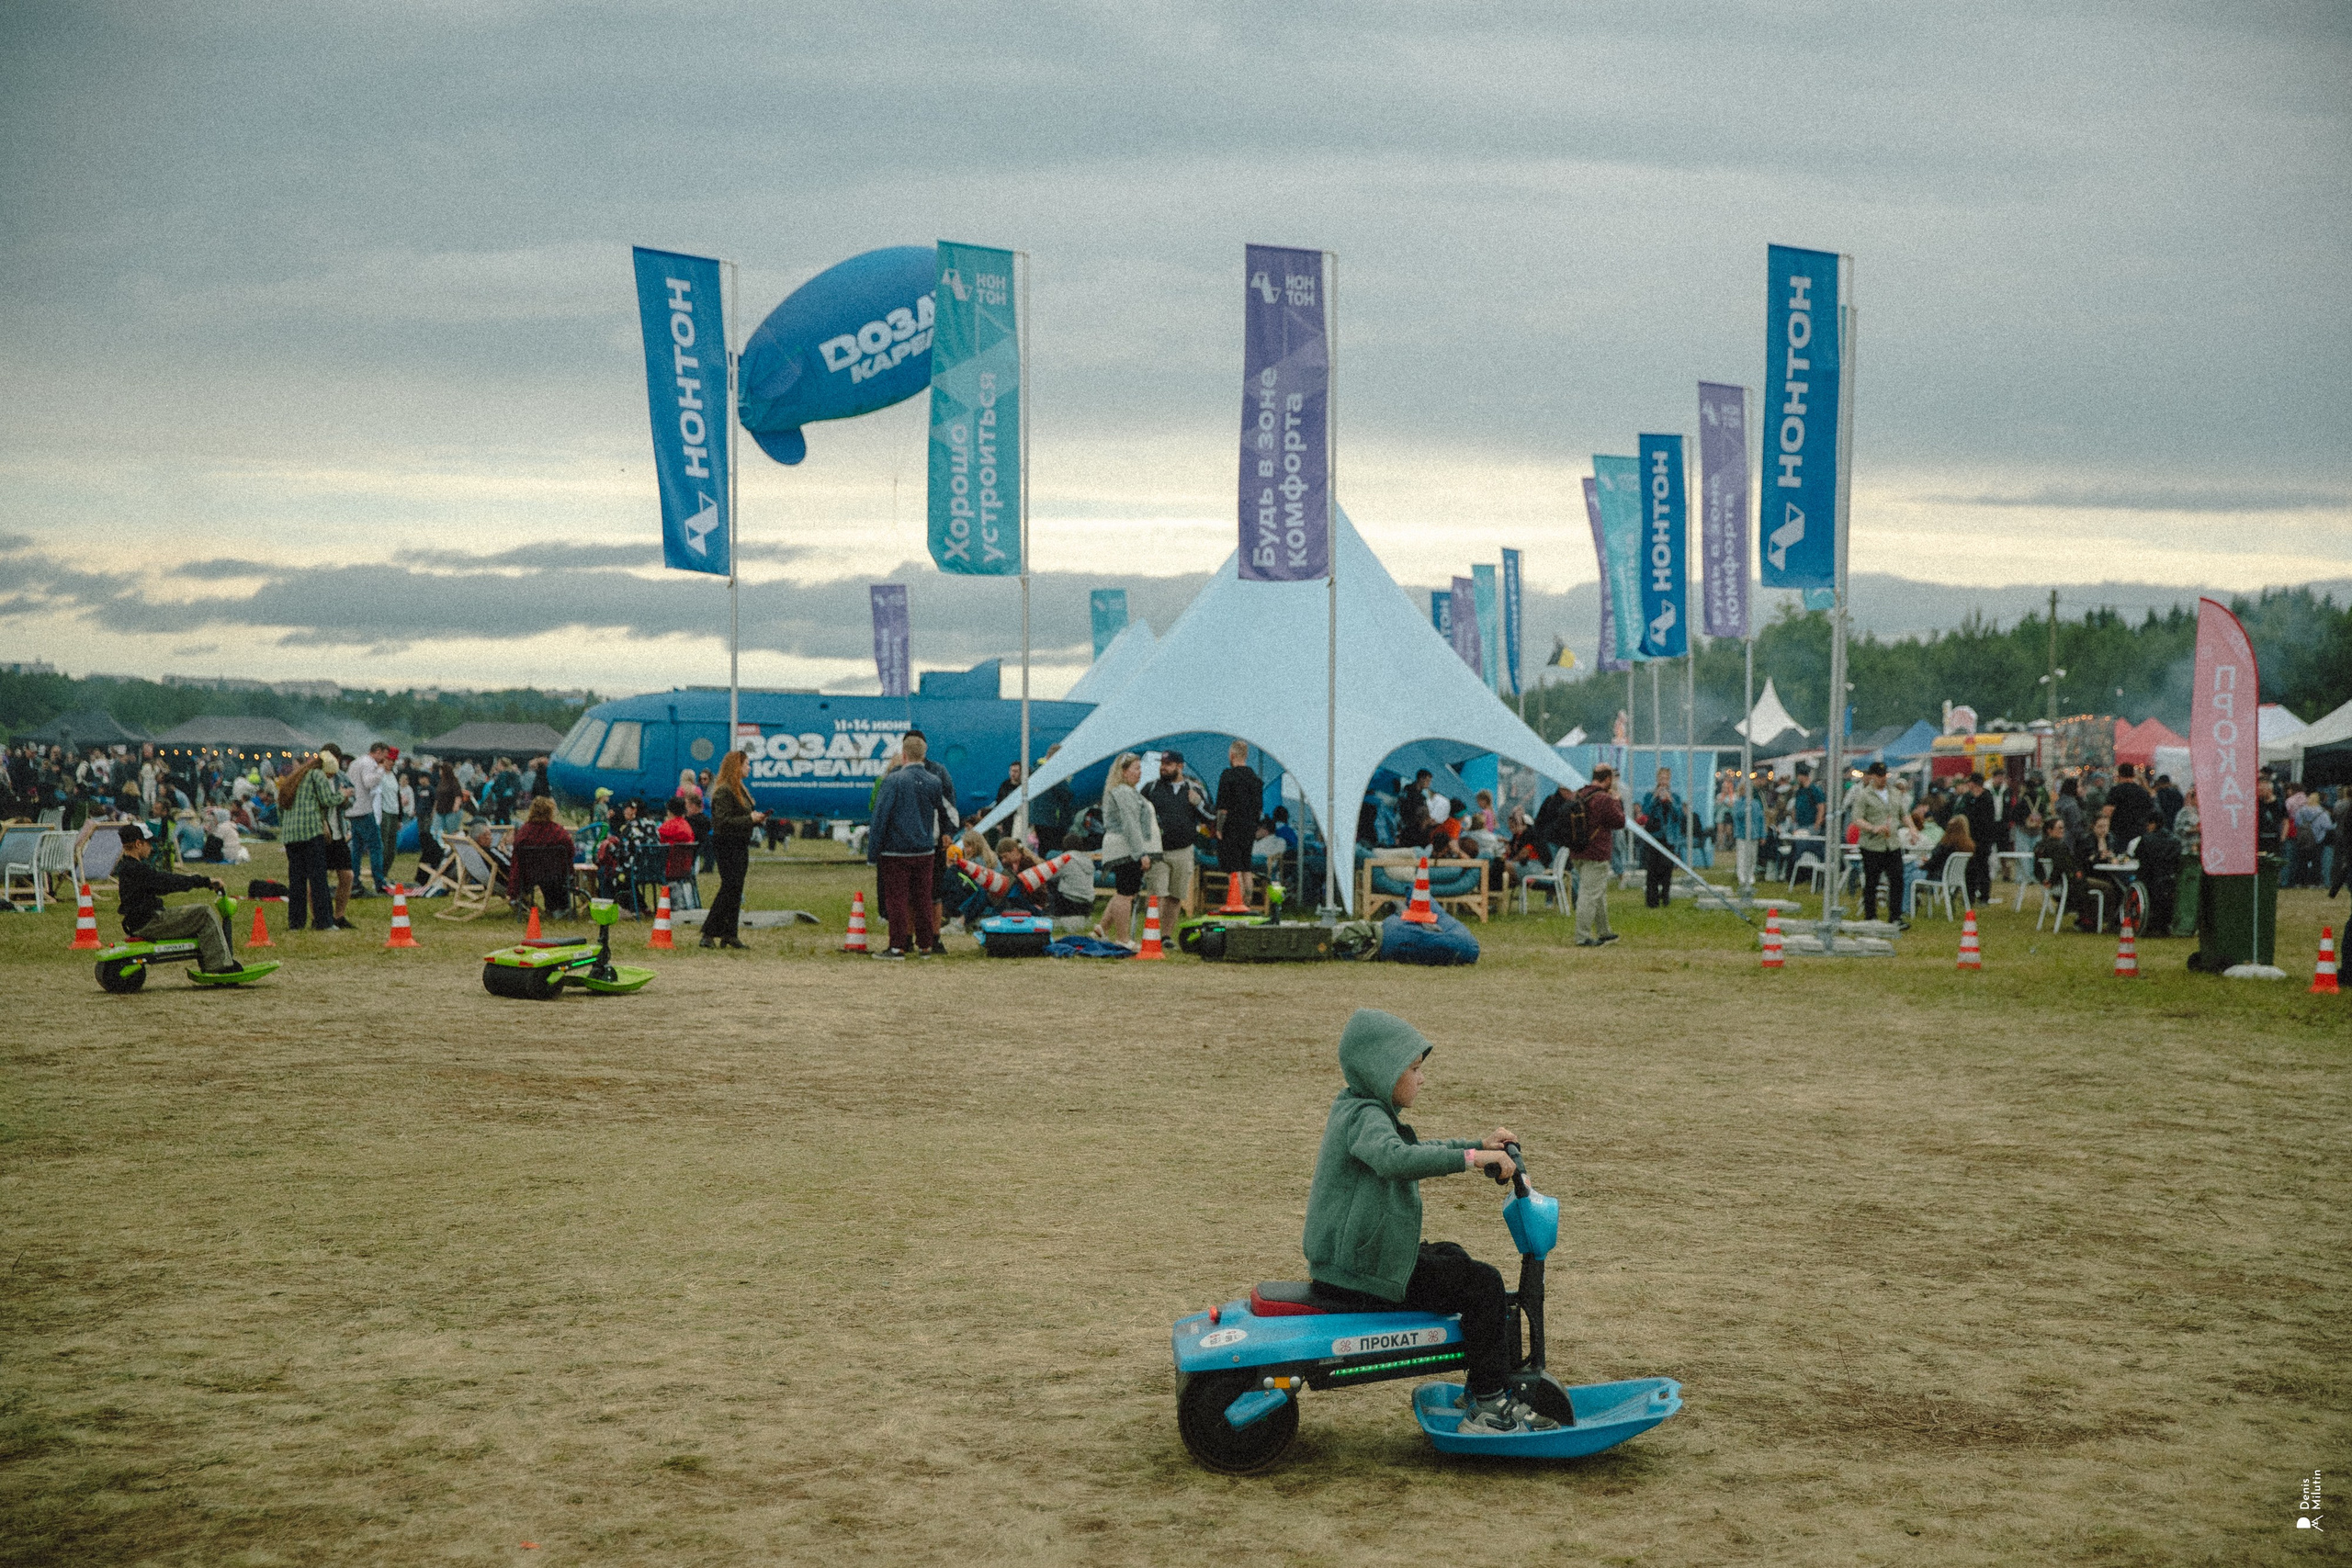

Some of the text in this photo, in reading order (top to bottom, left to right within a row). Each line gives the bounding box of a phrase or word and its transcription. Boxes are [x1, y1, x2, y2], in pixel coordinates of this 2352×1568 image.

[819, 289, 936, 373] ВОЗД
[978, 289, 1007, 306] ТОН
[1286, 290, 1316, 306] ТОН
[665, 276, 710, 479] НОНТОН
[1777, 276, 1812, 488] НОНТОН
[944, 423, 976, 562] Хорошо
[978, 371, 1006, 563] устроиться
[1252, 367, 1280, 568] Будь в зоне
[1278, 392, 1309, 568] комфорта
[1651, 450, 1672, 592] НОНТОН
[1360, 1332, 1419, 1350] ПРОКАТ
